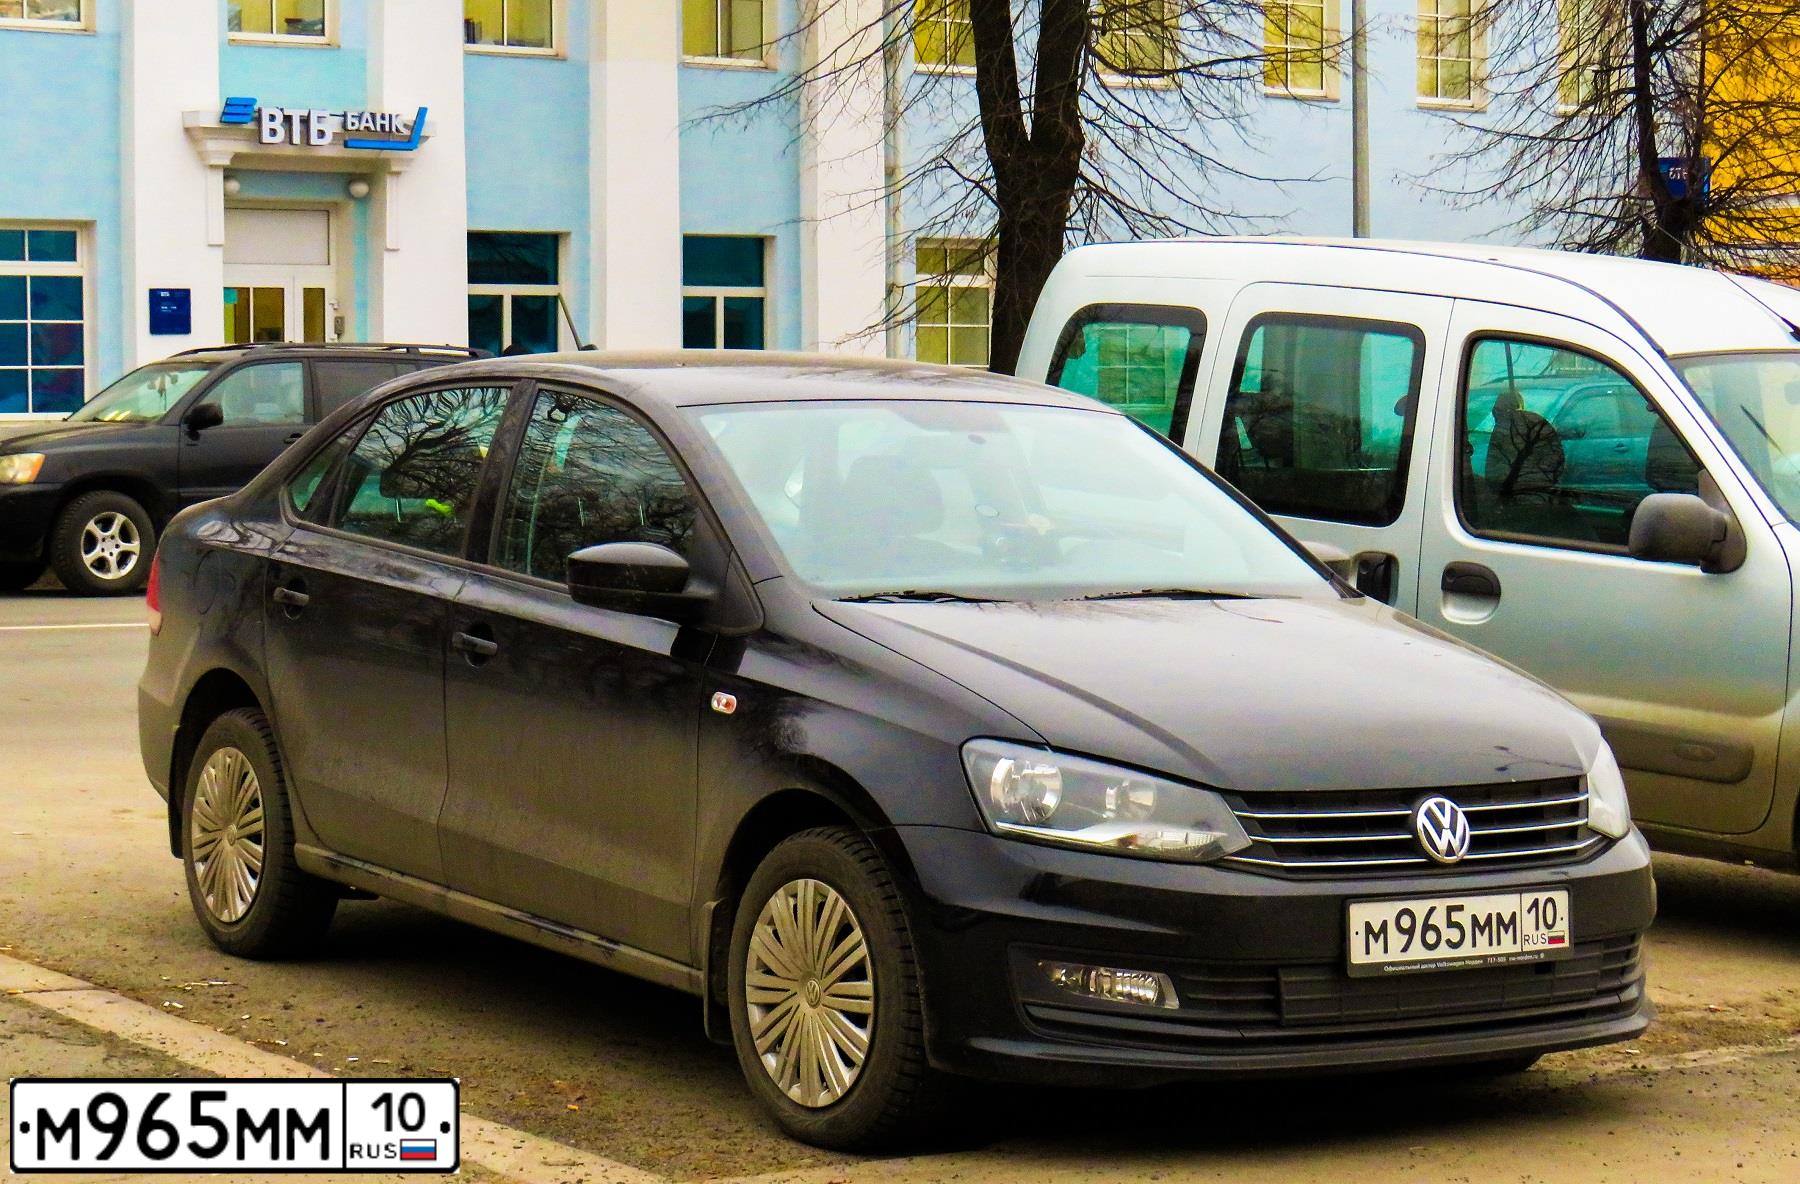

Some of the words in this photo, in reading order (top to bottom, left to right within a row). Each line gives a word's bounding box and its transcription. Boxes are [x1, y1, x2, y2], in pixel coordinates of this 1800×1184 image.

[258, 106, 333, 146] ВТБ
[344, 110, 408, 135] БАНК
[1363, 903, 1518, 956] М965ММ
[1526, 896, 1558, 932] 10
[1523, 933, 1547, 946] RUS
